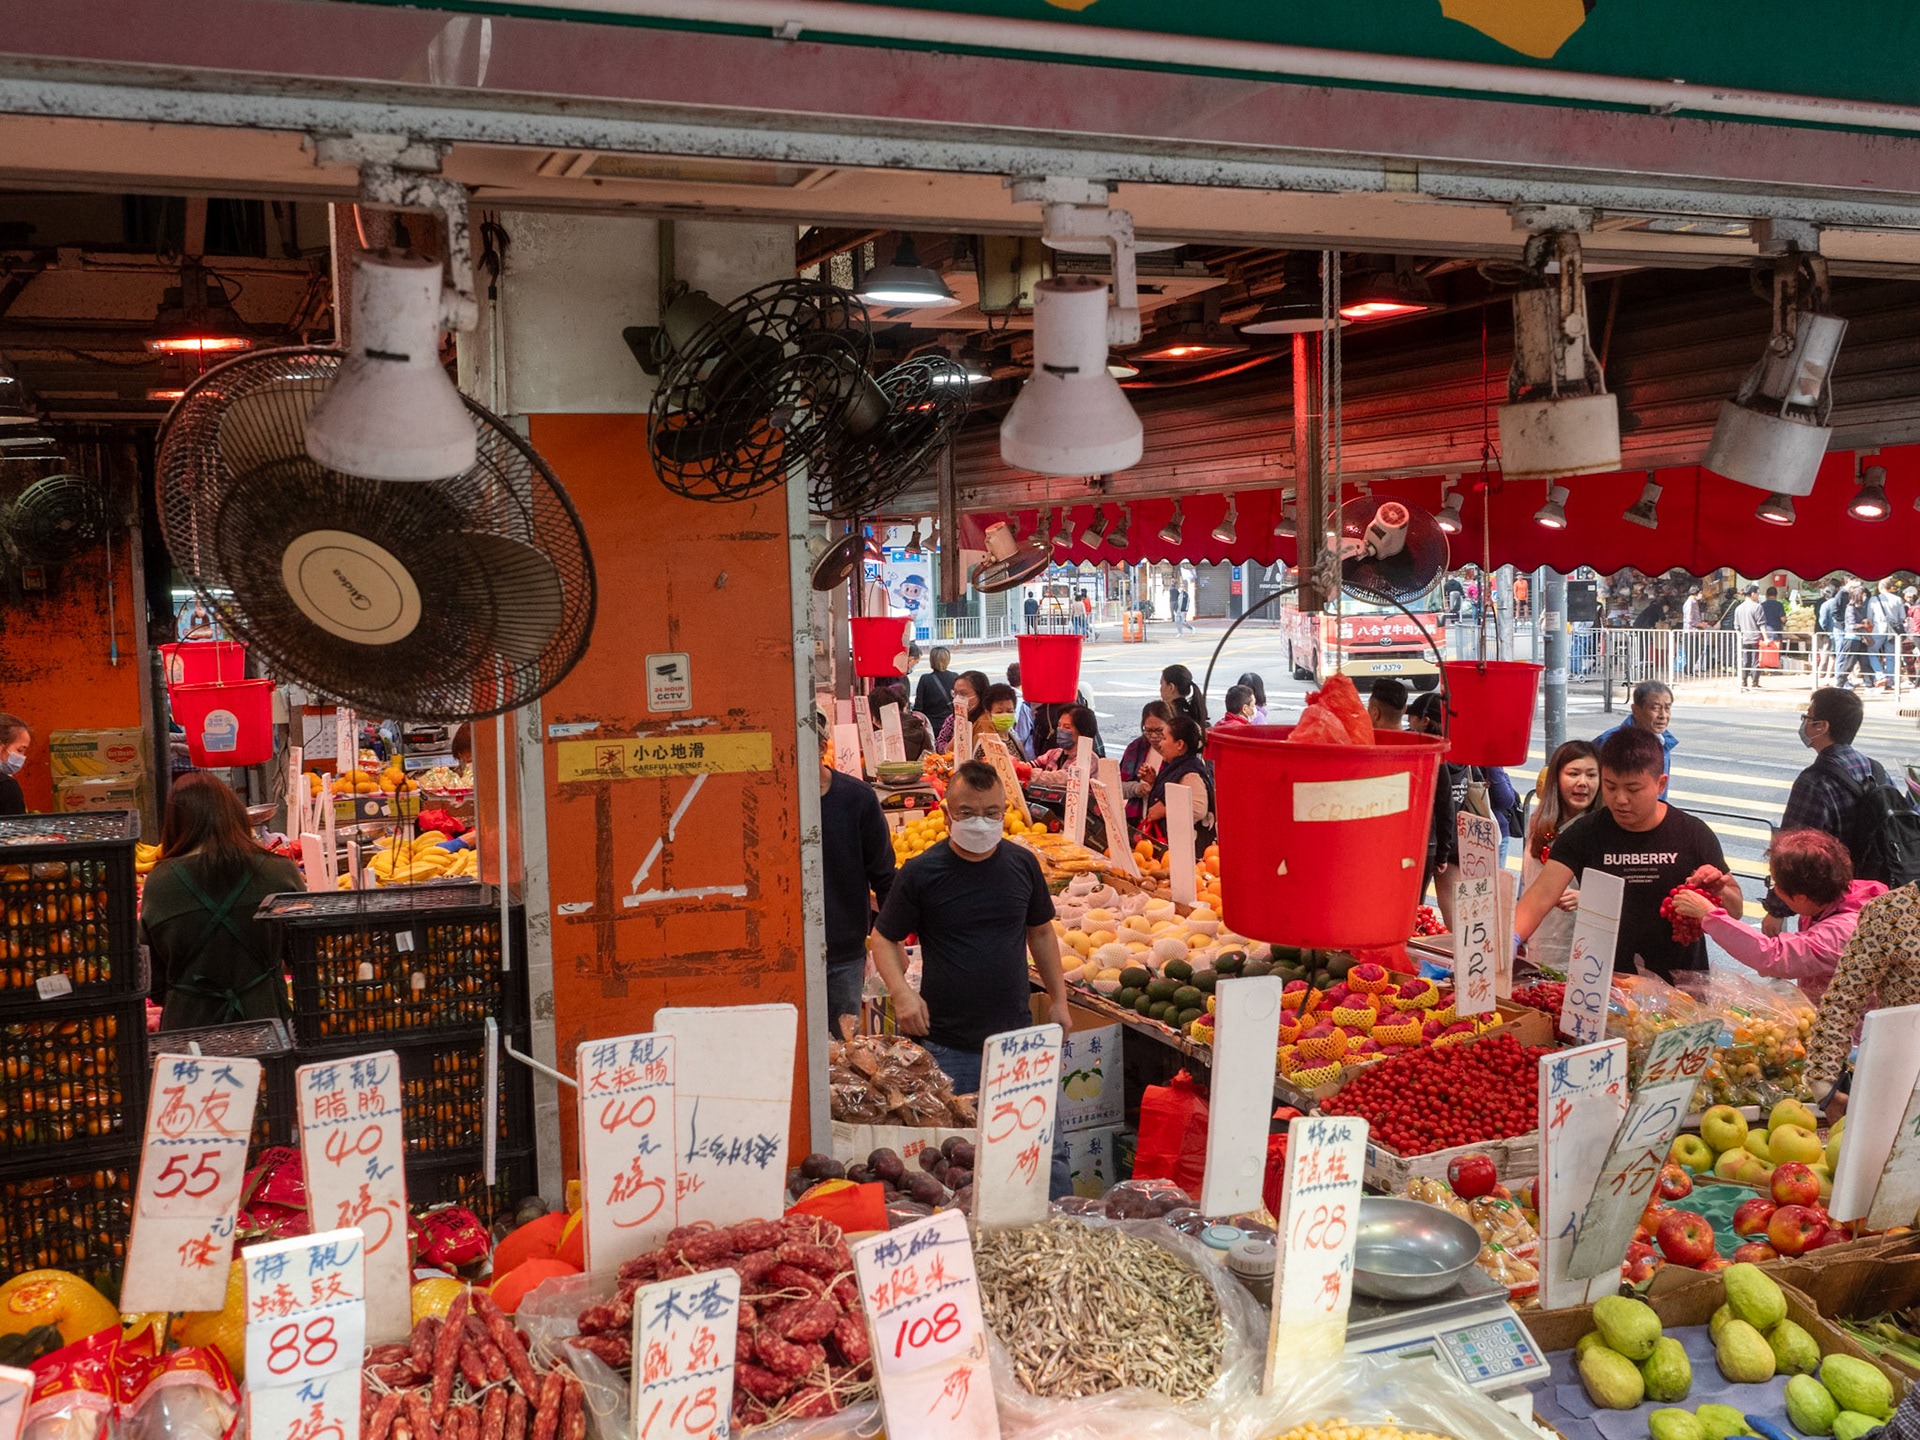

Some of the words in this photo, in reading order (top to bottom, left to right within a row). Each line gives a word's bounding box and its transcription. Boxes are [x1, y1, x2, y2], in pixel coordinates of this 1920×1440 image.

[332, 569, 372, 610] Midea
[633, 742, 705, 762] 小心地滑
[1603, 852, 1679, 865] BURBERRY
[1464, 922, 1487, 947] 15
[1468, 952, 1488, 976] 2
[173, 1060, 245, 1089] 特大
[1551, 1048, 1614, 1094] 澳洲
[599, 1095, 656, 1134] 40
[987, 1095, 1046, 1144] 30
[1626, 1096, 1682, 1143] 15
[325, 1124, 383, 1167] 40
[638, 1133, 662, 1155] 元
[153, 1150, 222, 1198] 55
[365, 1155, 394, 1181] 元
[1292, 1203, 1348, 1252] 128
[647, 1278, 734, 1332] 本港
[267, 1315, 338, 1376] 88
[894, 1302, 962, 1359] 108
[296, 1378, 331, 1403] 元
[641, 1386, 718, 1440] 118
